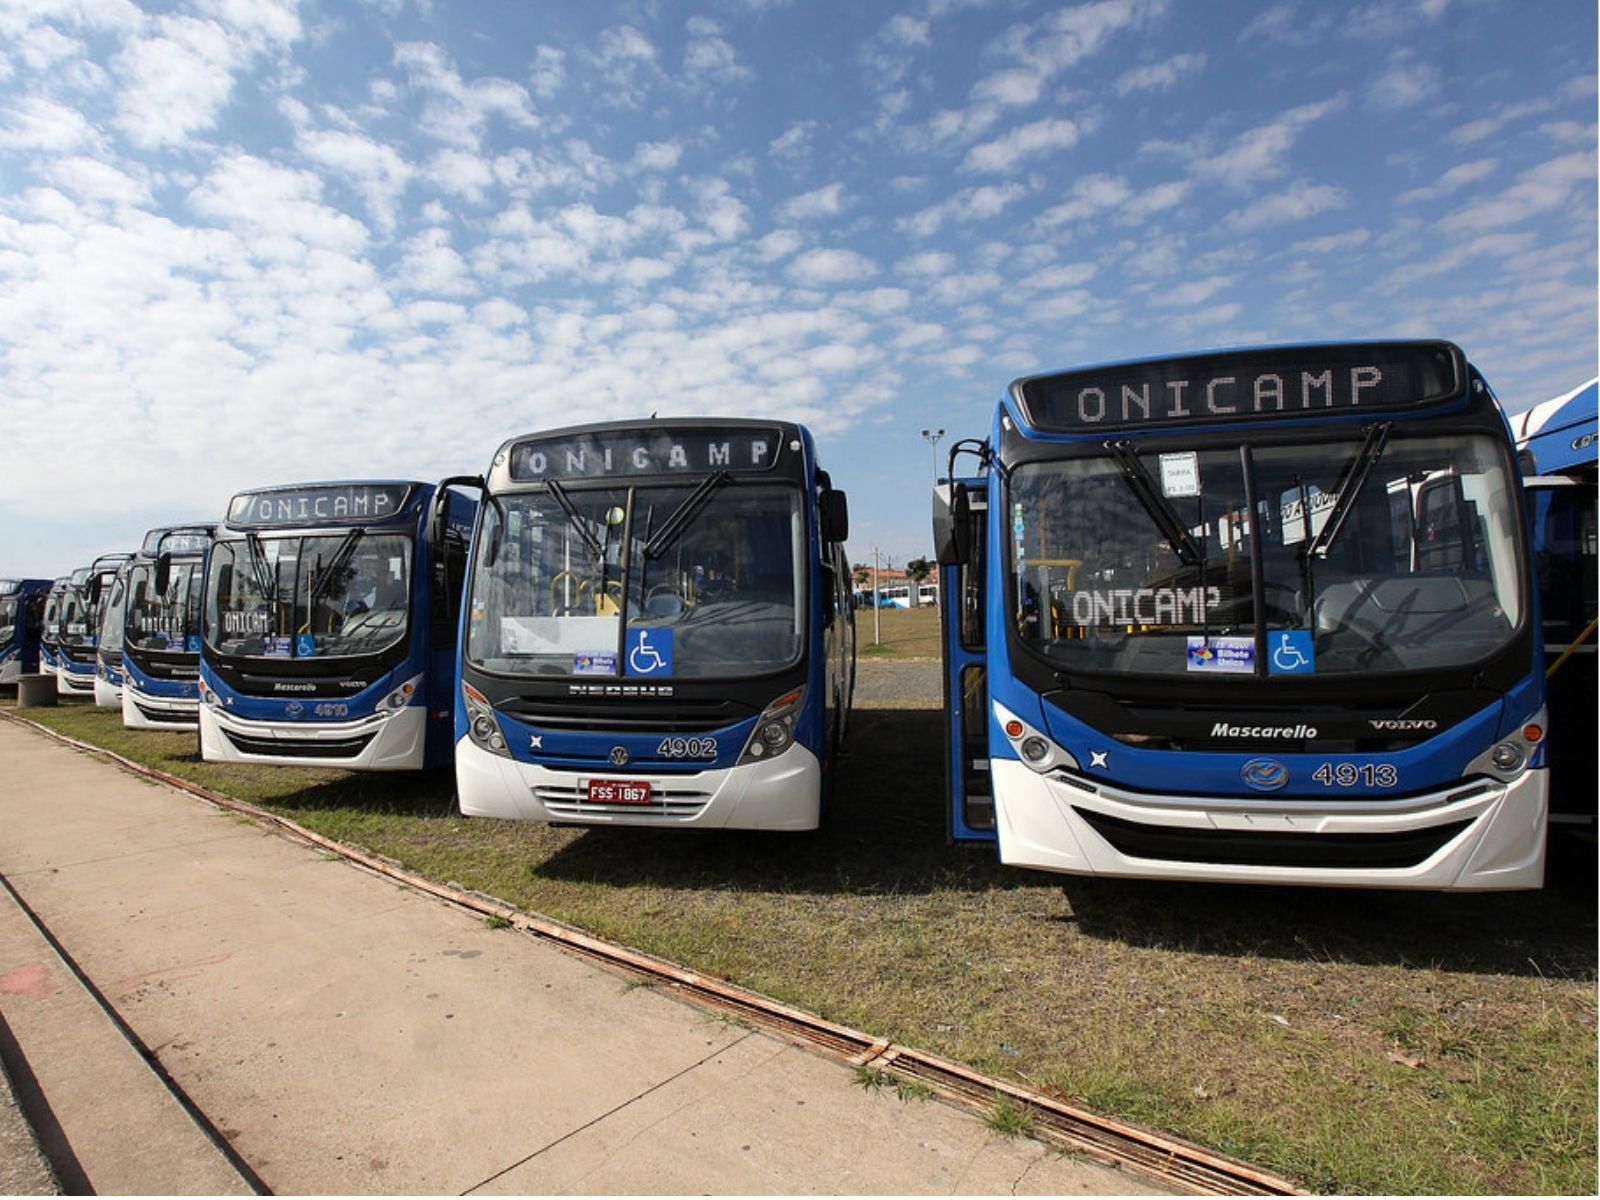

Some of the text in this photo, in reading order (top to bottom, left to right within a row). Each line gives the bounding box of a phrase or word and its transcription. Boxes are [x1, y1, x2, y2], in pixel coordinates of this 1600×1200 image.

[1077, 365, 1383, 423] ONICAMP
[528, 440, 769, 474] ONICAMP
[258, 493, 389, 520] ONICAMP
[1072, 585, 1222, 626] ONICAMP
[1210, 722, 1319, 740] Mascarello
[1368, 719, 1438, 730] VOLVO
[656, 737, 718, 758] 4902
[1311, 762, 1399, 788] 4913
